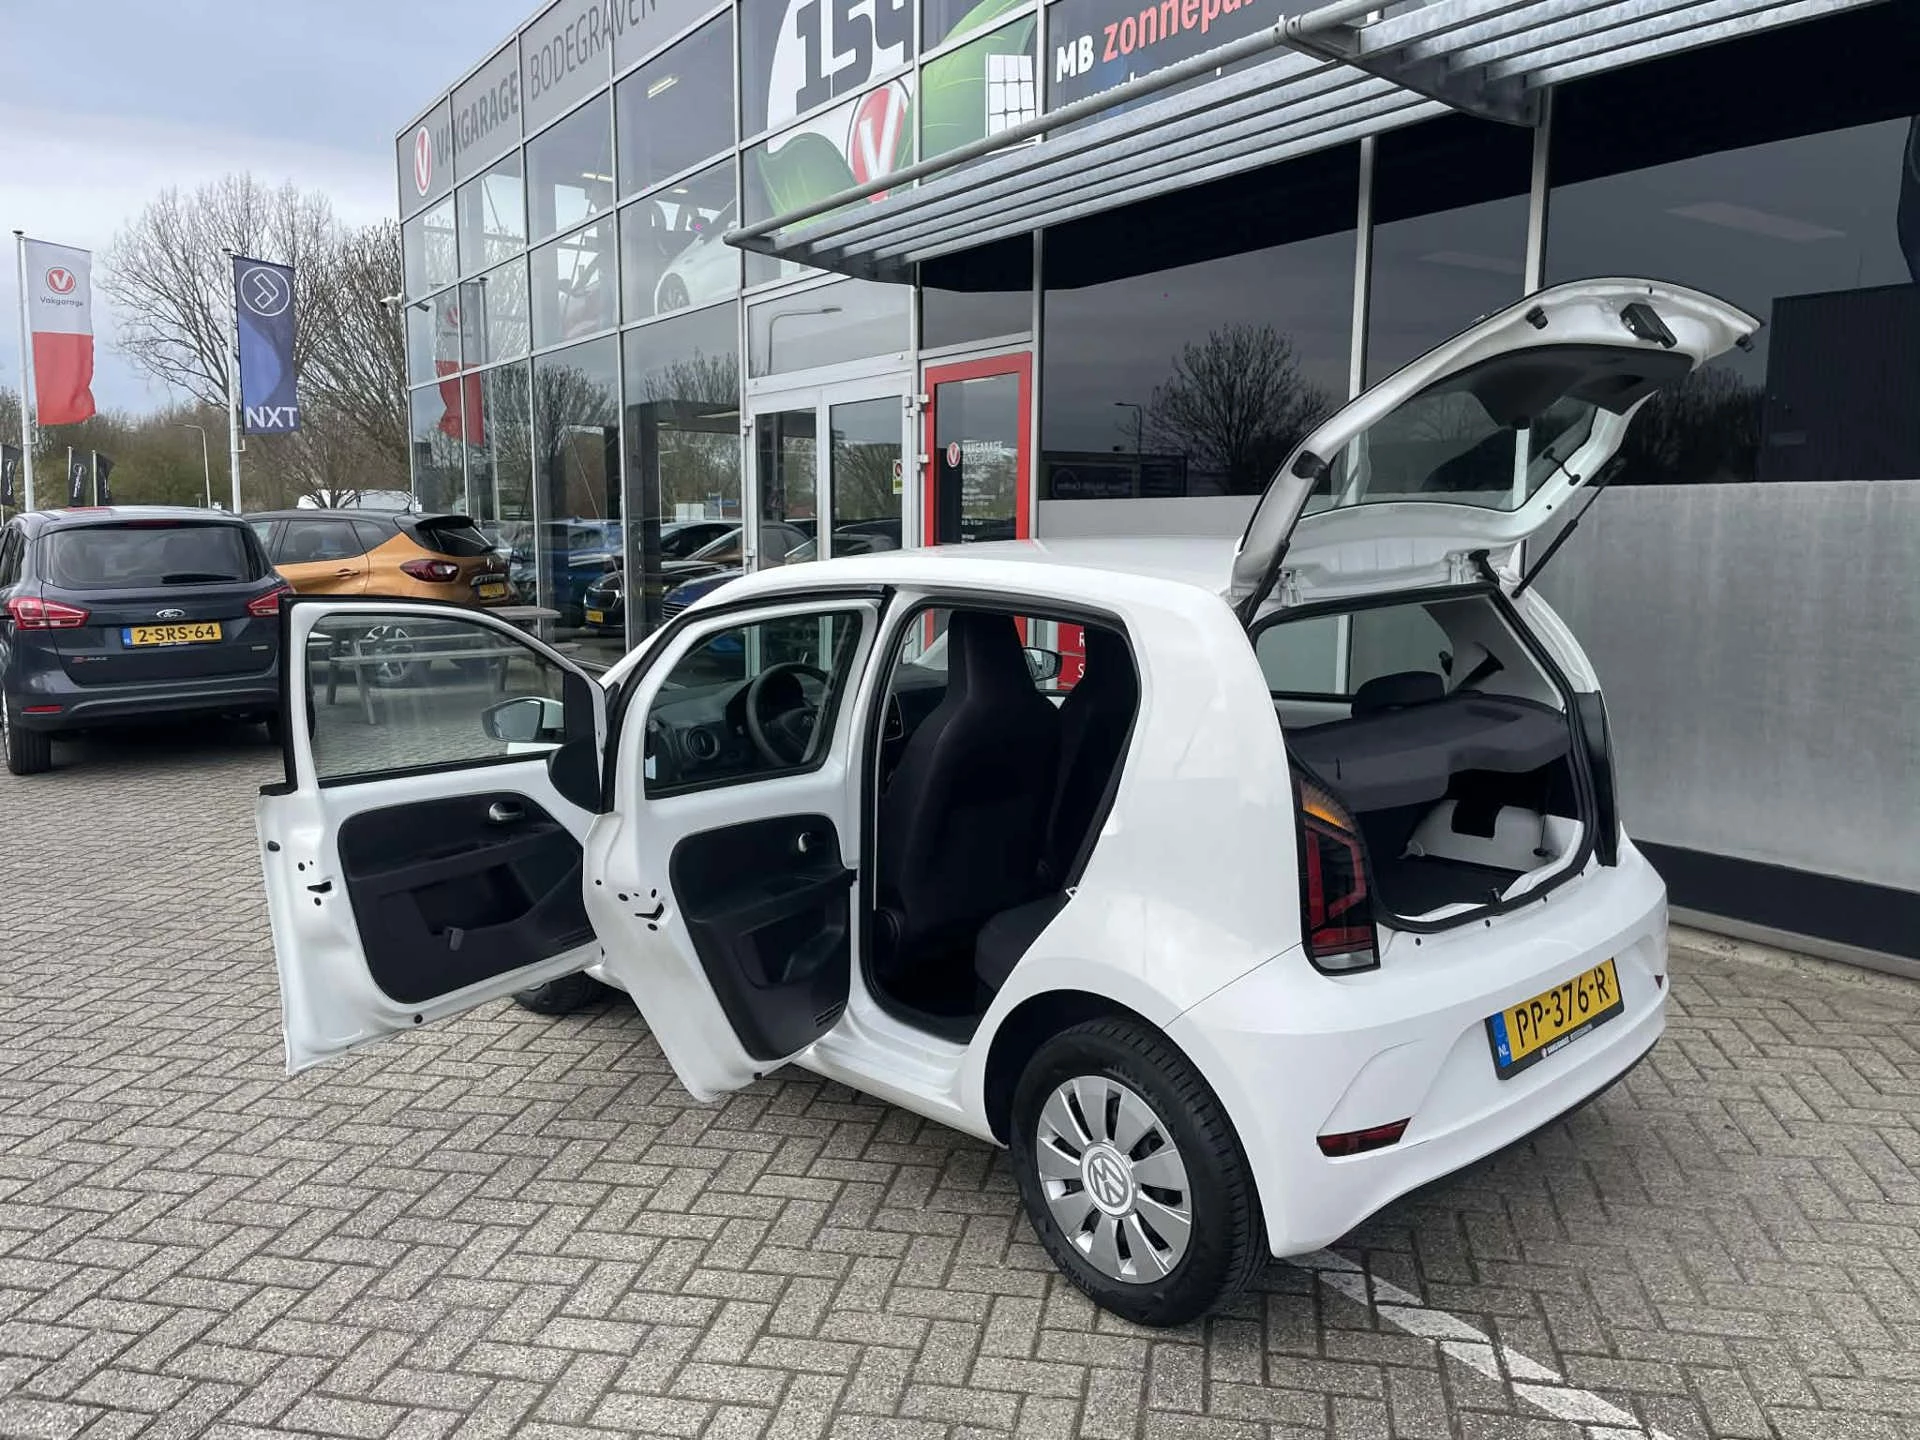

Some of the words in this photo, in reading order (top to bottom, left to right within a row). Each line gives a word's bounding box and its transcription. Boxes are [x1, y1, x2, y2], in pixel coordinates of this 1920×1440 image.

[1056, 35, 1094, 83] MB
[1103, 0, 1254, 63] zonnep
[436, 70, 518, 167] VAKGARAGE
[246, 406, 297, 428] NXT
[137, 625, 215, 643] 2-SRS-64
[1515, 967, 1610, 1048] PP-376-R
[1498, 1044, 1509, 1056] NL
